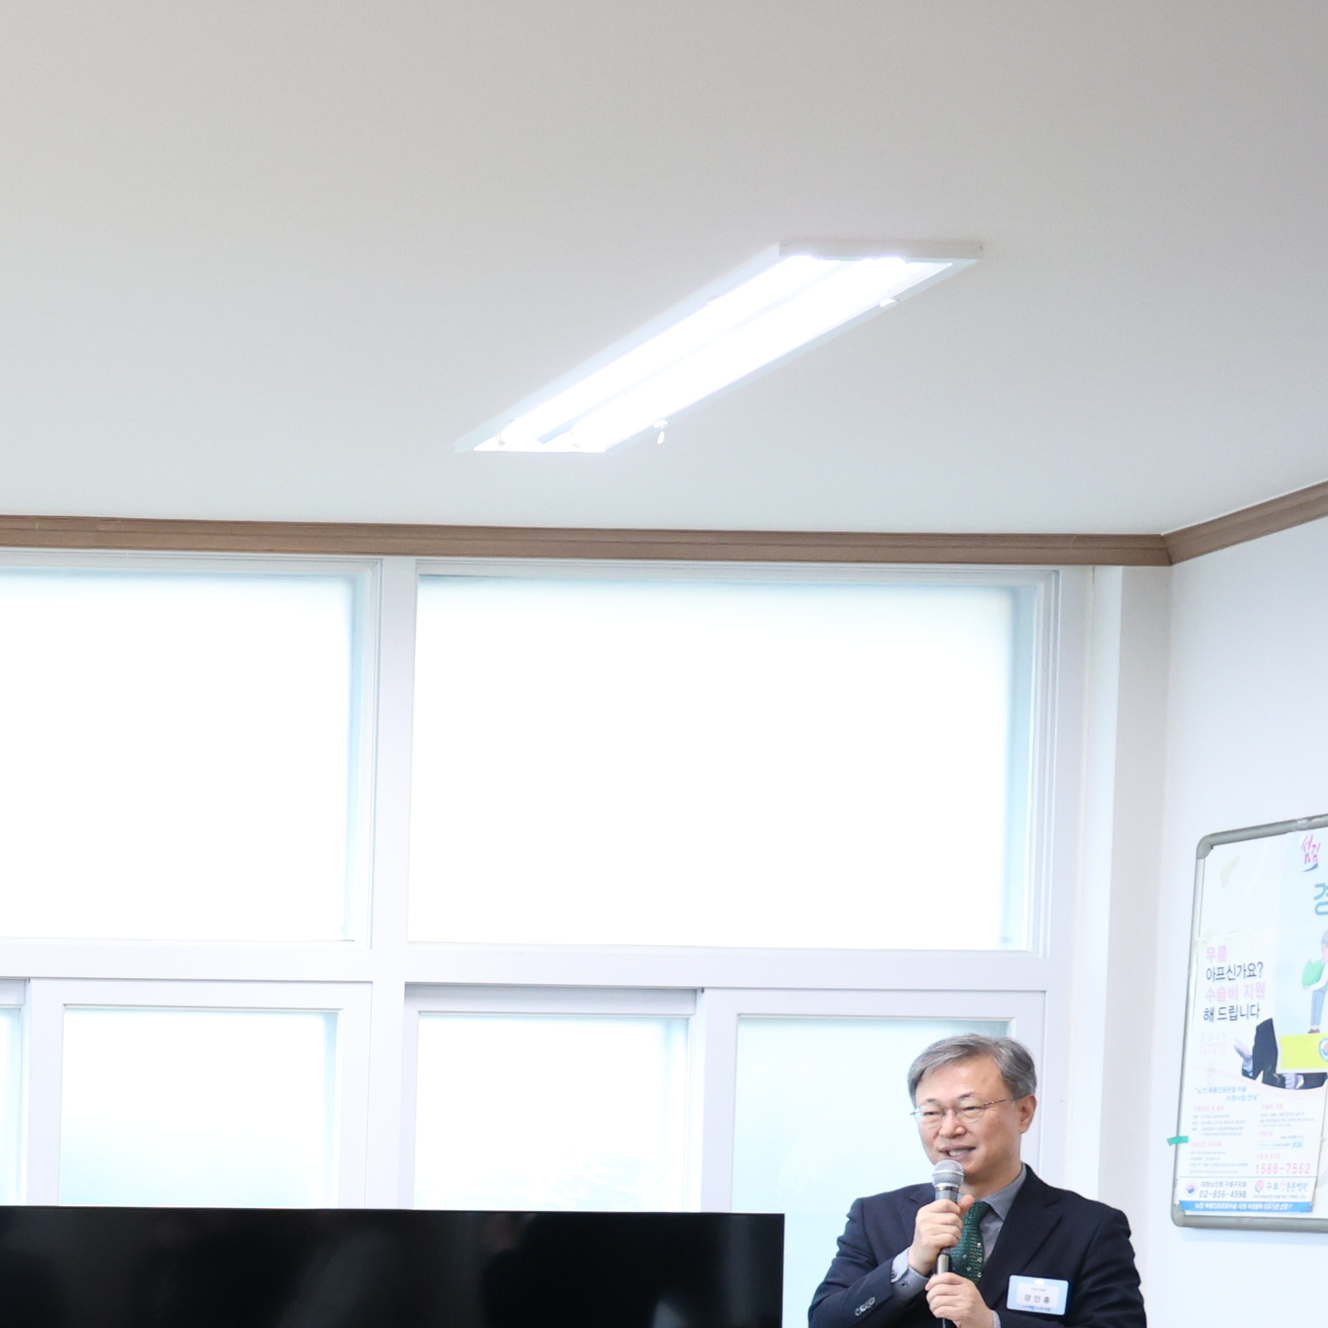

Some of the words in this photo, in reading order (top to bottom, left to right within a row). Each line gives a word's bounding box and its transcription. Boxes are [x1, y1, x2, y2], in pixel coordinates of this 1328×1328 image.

[1206, 945, 1228, 962] 무릎
[1206, 962, 1263, 982] 아프신가요?
[1205, 987, 1238, 1003] 수술비
[1243, 982, 1265, 998] 지원
[1203, 1007, 1215, 1022] 해
[1217, 1003, 1260, 1021] 드립니다
[1256, 1163, 1310, 1174] 1588-7562
